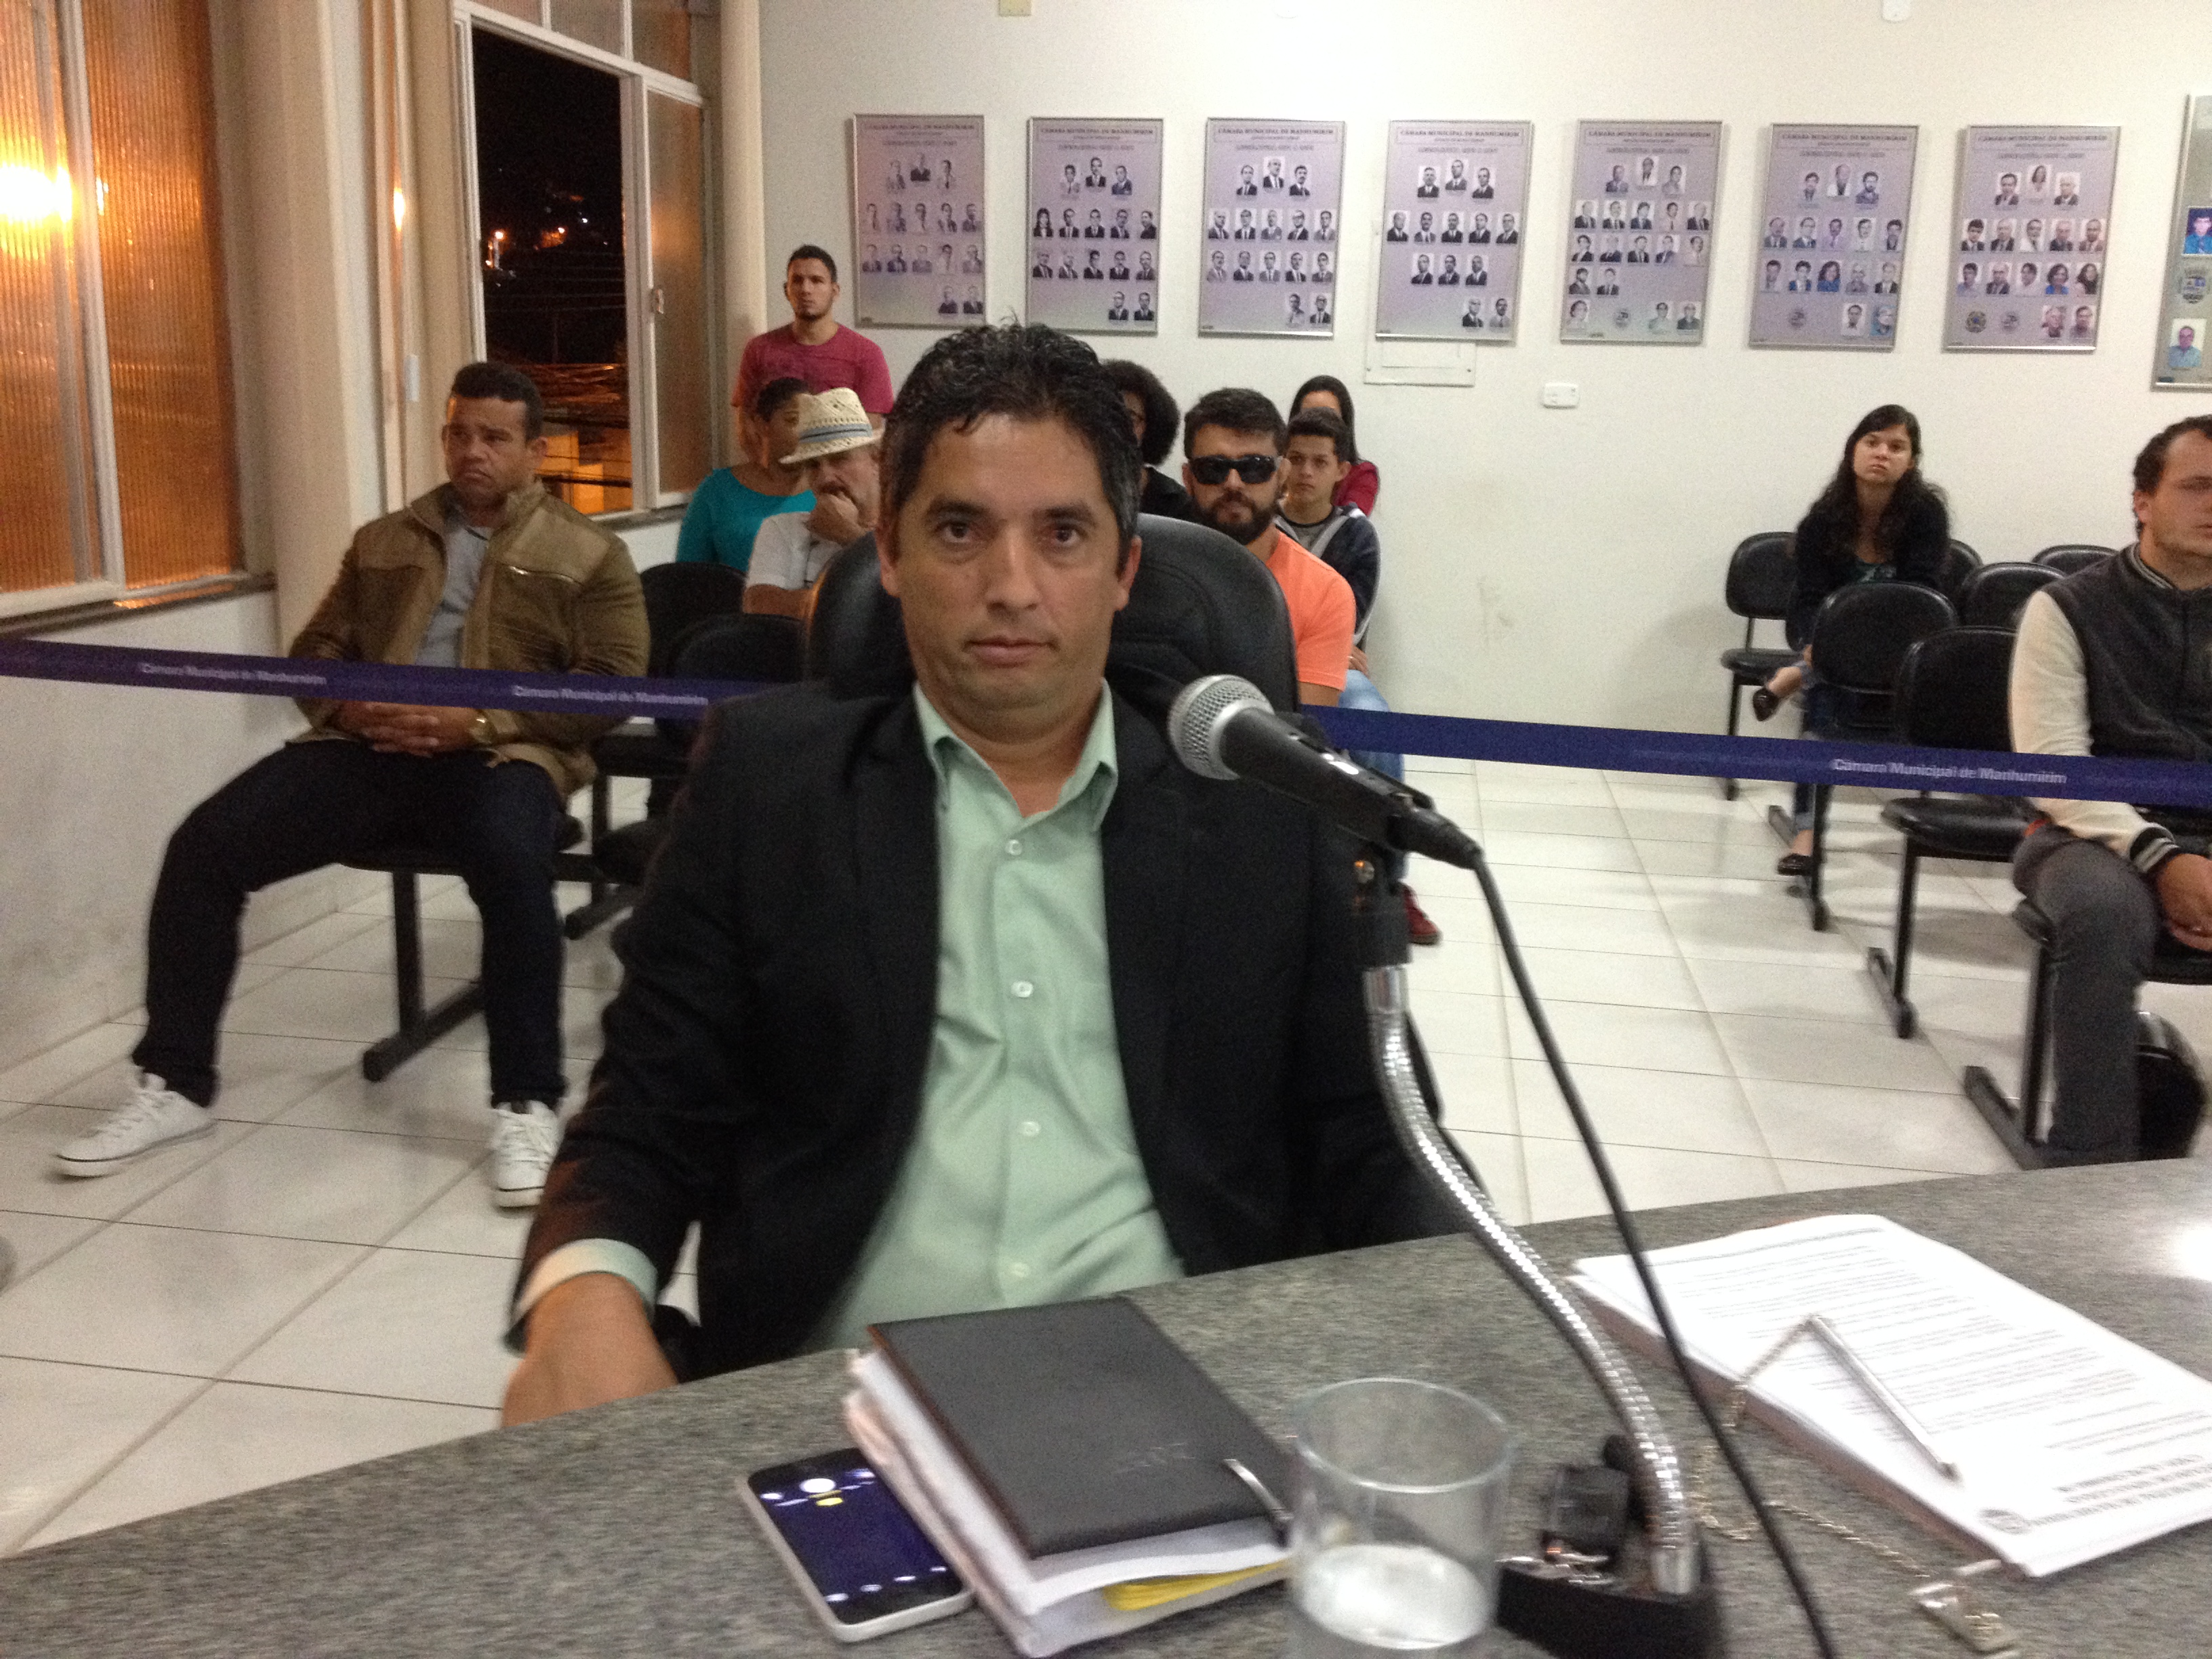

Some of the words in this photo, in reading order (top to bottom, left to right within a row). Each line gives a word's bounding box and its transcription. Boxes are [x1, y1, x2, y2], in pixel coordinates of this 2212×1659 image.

[618, 691, 634, 702] de
[1831, 758, 1886, 773] Câmara
[1887, 761, 1958, 779] Municipal
[1959, 766, 1977, 779] de
[1978, 766, 2067, 783] Manhumirim
